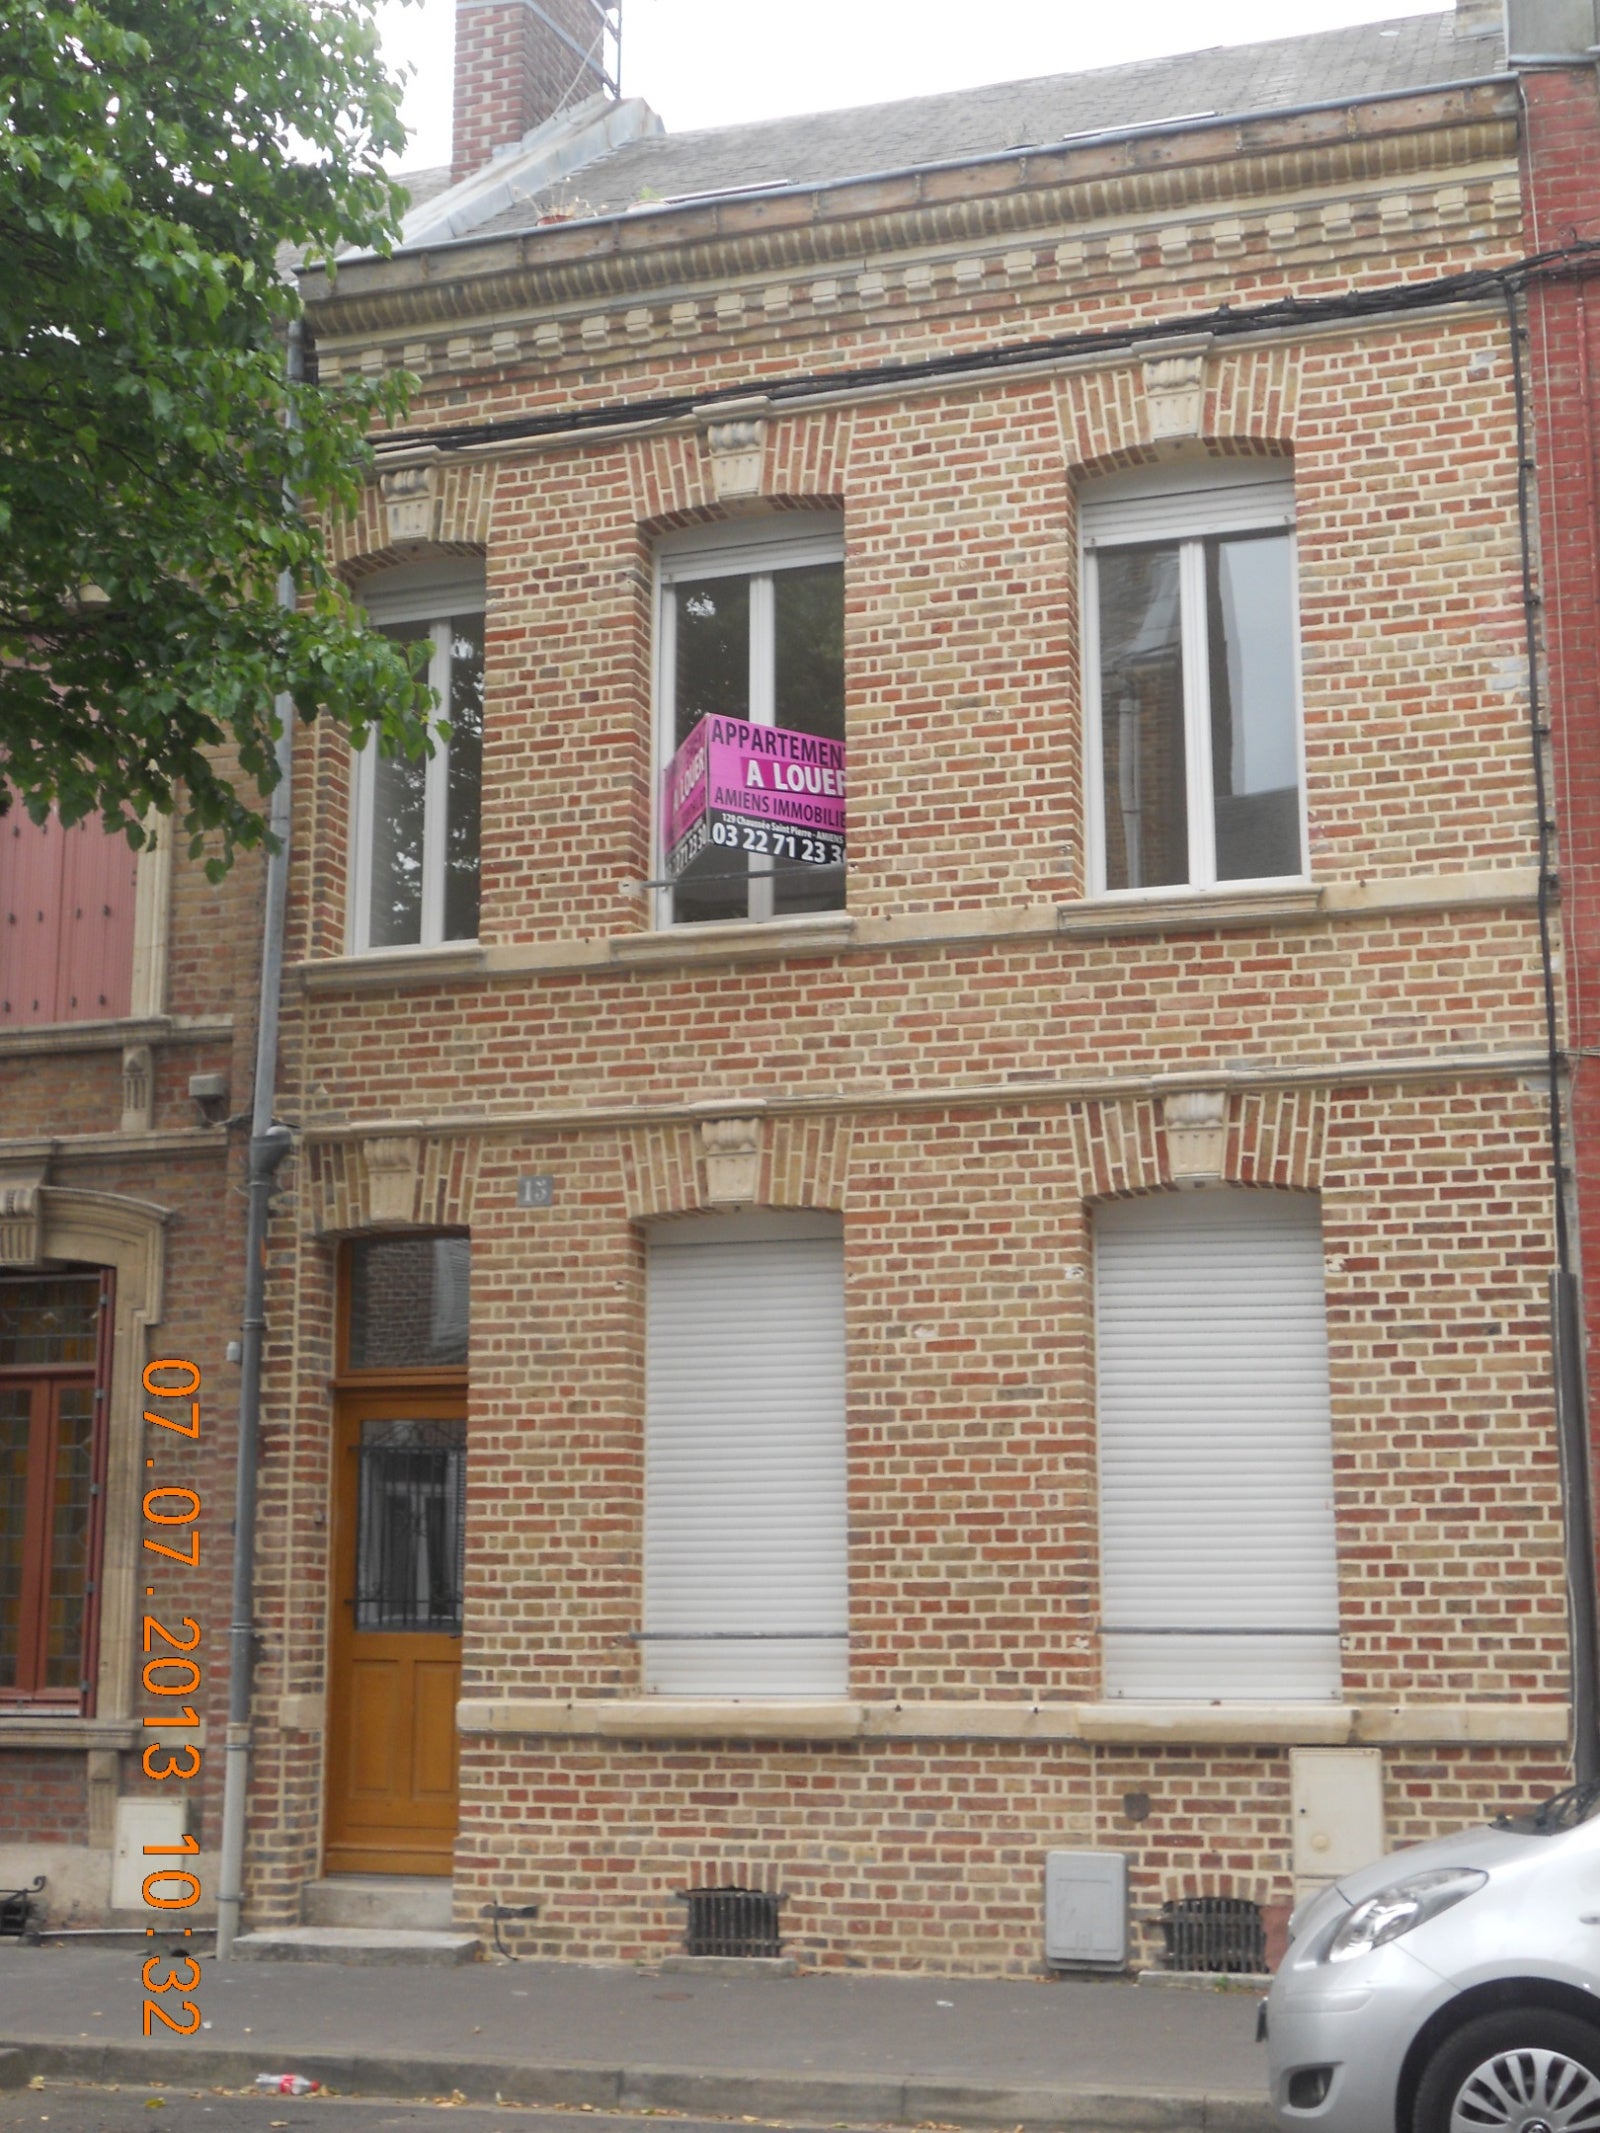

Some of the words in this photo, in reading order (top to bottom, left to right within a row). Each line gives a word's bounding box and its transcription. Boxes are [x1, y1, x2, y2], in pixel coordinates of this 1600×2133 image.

[711, 719, 846, 768] APPARTEMEN
[746, 759, 764, 787] A
[714, 787, 769, 812] AMIENS
[712, 822, 738, 846] 03
[743, 828, 768, 852] 22
[773, 833, 795, 857] 71
[801, 839, 826, 863] 23
